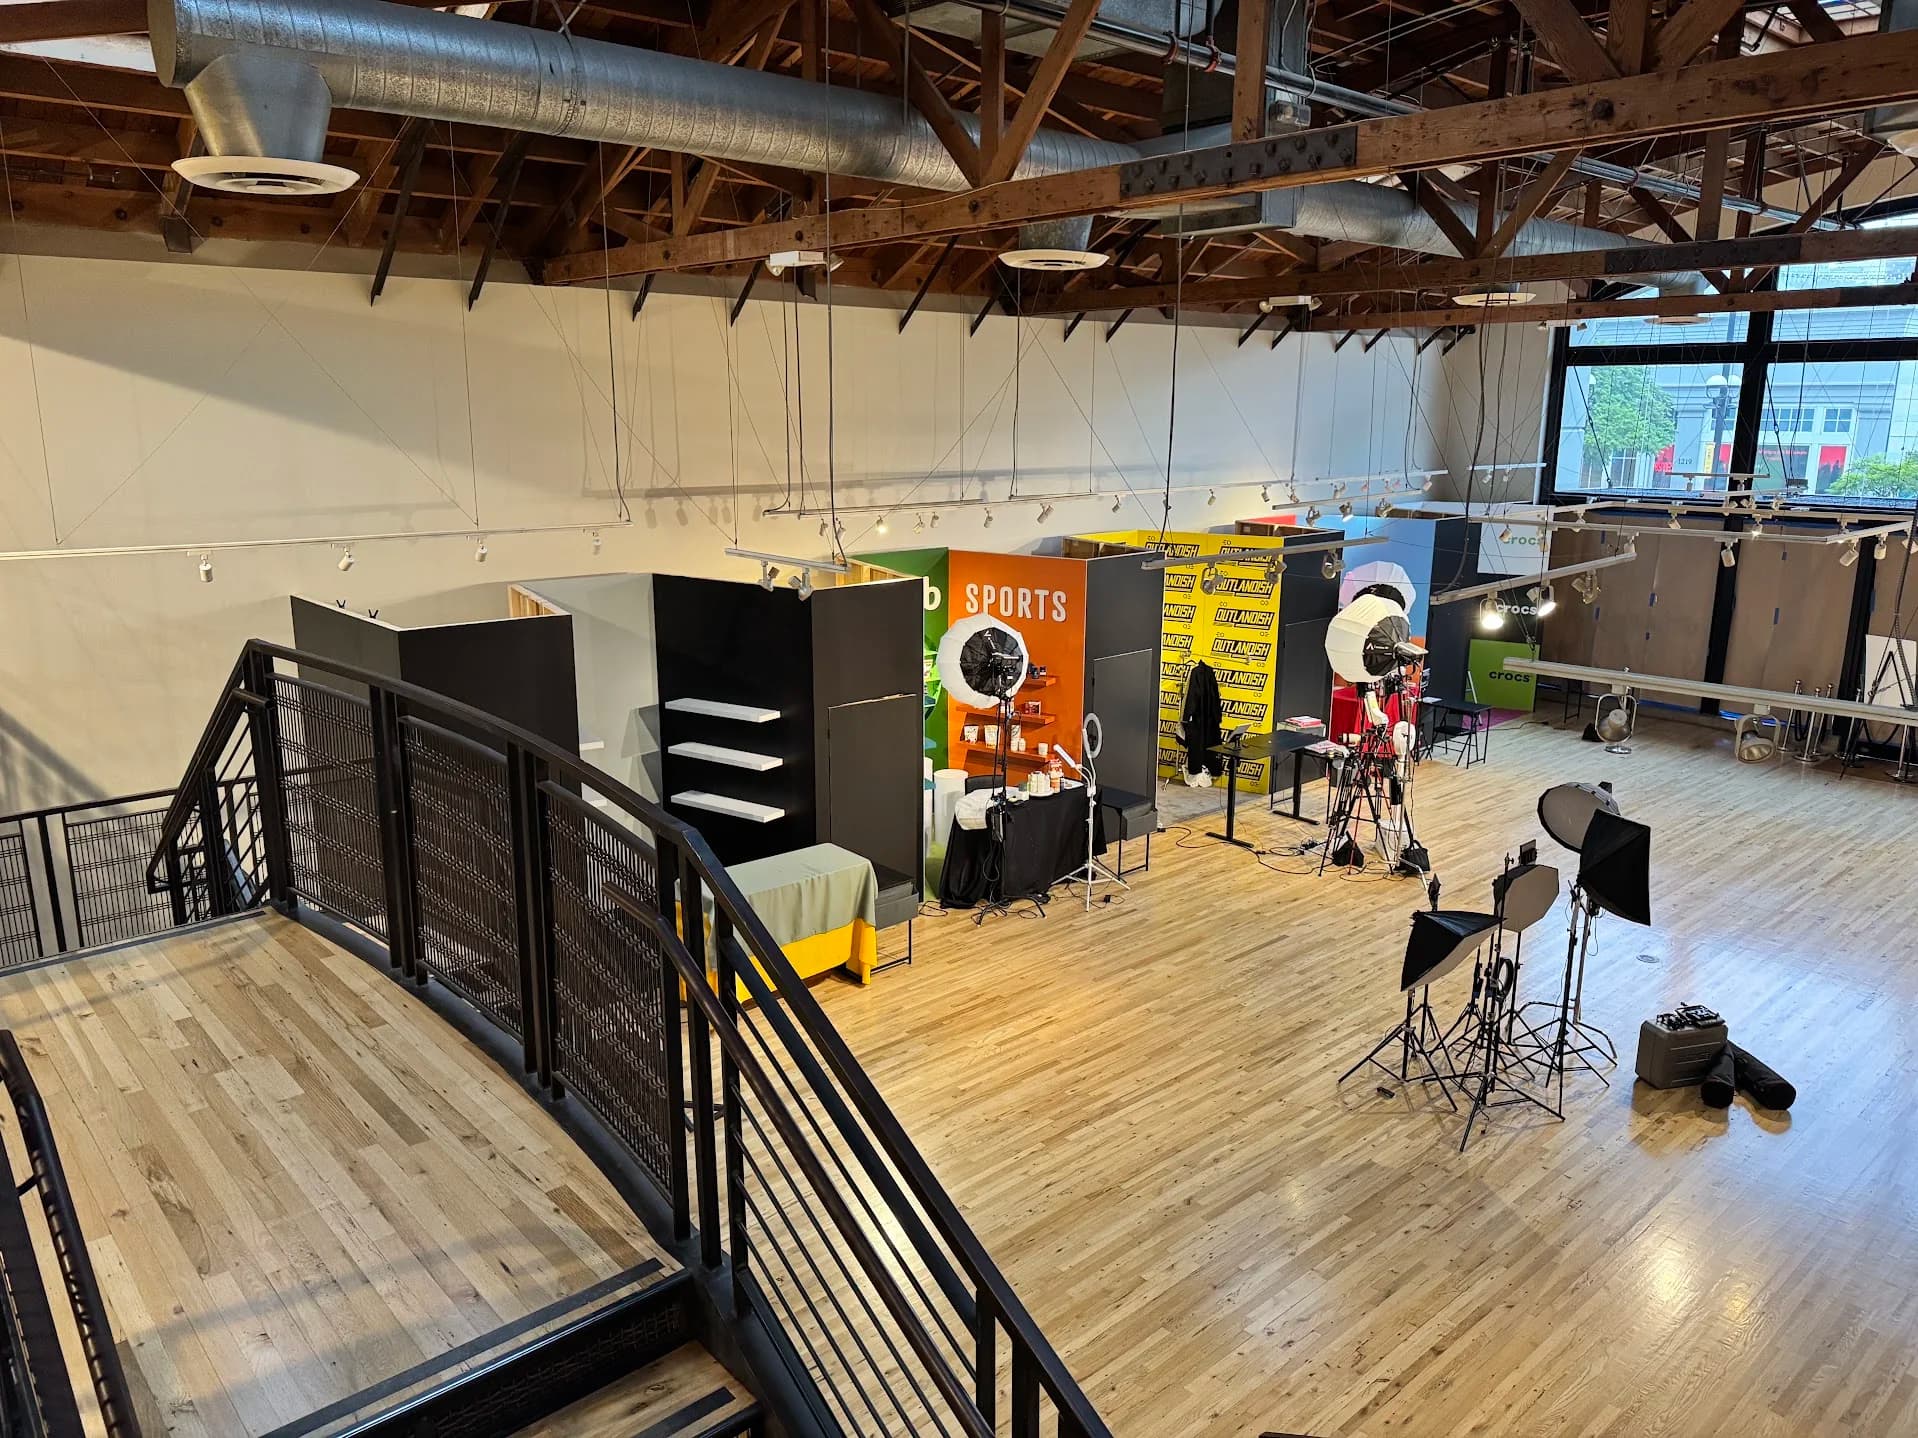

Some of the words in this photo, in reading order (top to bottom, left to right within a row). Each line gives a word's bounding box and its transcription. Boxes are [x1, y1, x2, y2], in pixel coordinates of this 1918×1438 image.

[1503, 536, 1541, 546] roc
[965, 583, 1067, 622] SPORTS
[1496, 604, 1538, 616] crocs
[1163, 603, 1196, 619] ANDISH
[1215, 608, 1274, 625] OUTLANDISH
[1212, 639, 1270, 656] OUTLANDISH
[1489, 670, 1530, 683] crocs
